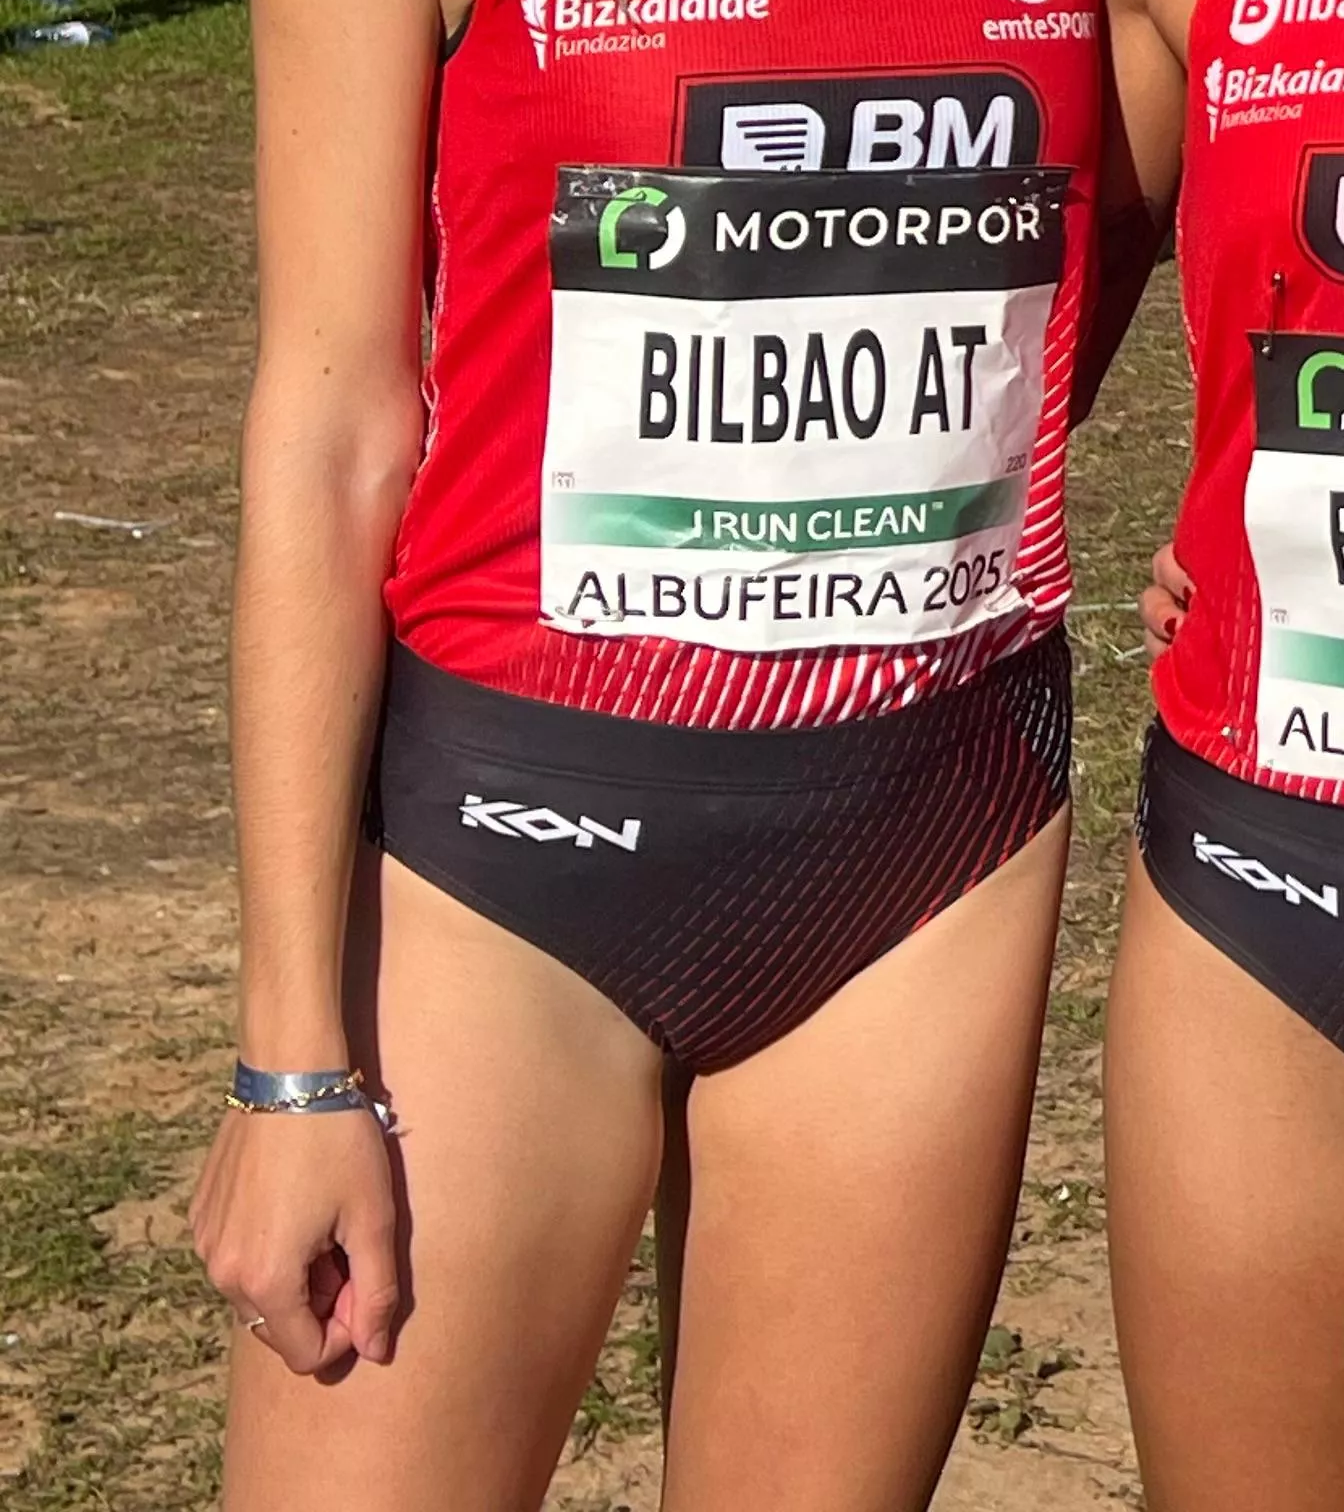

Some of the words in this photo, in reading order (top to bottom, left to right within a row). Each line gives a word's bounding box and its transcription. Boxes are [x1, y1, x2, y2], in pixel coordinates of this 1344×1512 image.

[555, 32, 666, 60] fundazioa
[982, 11, 1096, 41] emteSPORT
[847, 95, 1015, 172] BM
[1220, 103, 1304, 131] fundazioa
[714, 205, 1041, 253] MOTORPOR
[639, 327, 887, 444] BILBAO
[909, 324, 987, 435] AT
[713, 510, 798, 543] RUN
[567, 569, 908, 622] ALBUFEIRA
[923, 549, 1006, 614] 2025
